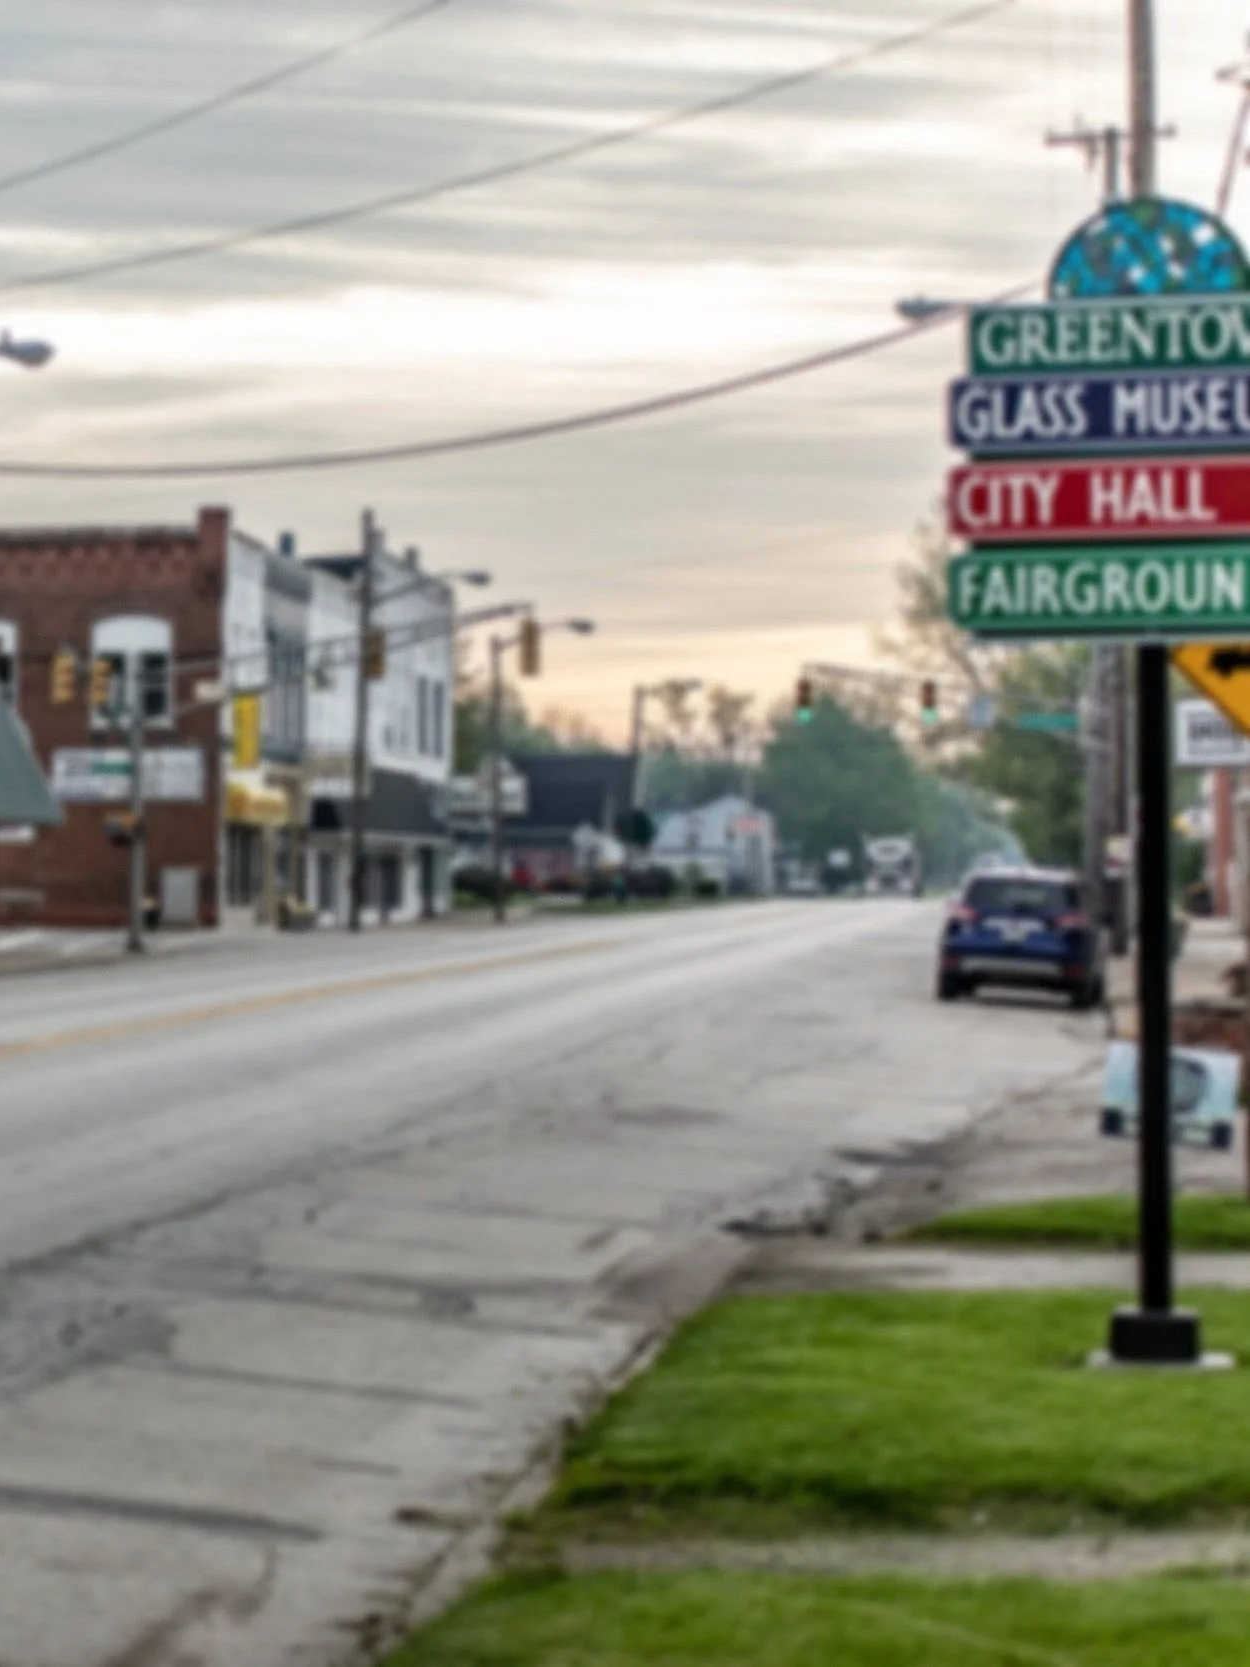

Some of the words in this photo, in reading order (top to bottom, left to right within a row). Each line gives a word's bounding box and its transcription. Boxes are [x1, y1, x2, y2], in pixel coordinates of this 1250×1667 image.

[957, 382, 1087, 439] GLASS
[958, 472, 1059, 526] CITY
[1090, 467, 1219, 523] HALL
[958, 558, 1244, 616] FAIRGROUN
